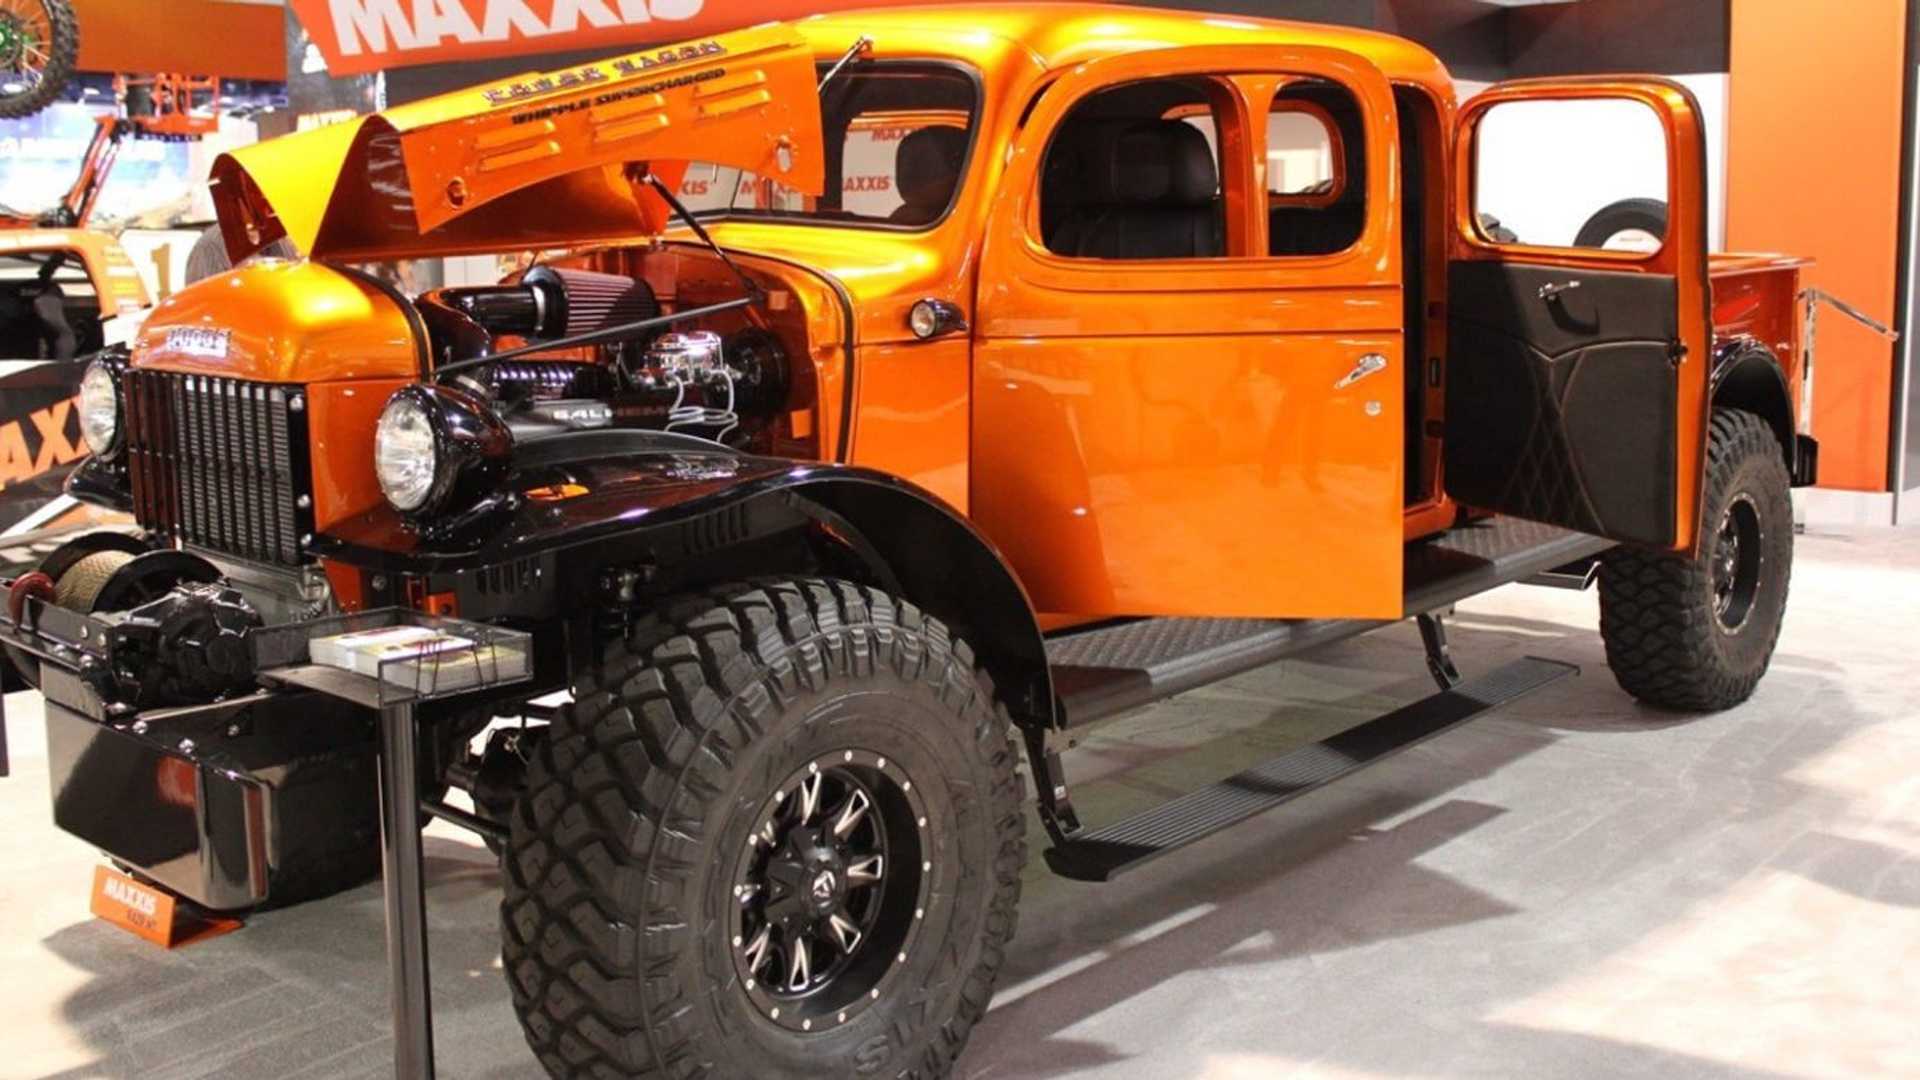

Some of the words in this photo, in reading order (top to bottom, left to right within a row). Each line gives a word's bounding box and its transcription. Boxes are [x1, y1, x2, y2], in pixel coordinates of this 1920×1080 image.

[327, 0, 704, 56] MAX
[613, 40, 727, 76] WAGON
[511, 99, 591, 125] WHIPPLE
[594, 68, 726, 106] SUPERCHARGED
[103, 875, 157, 917] MAXXIS
